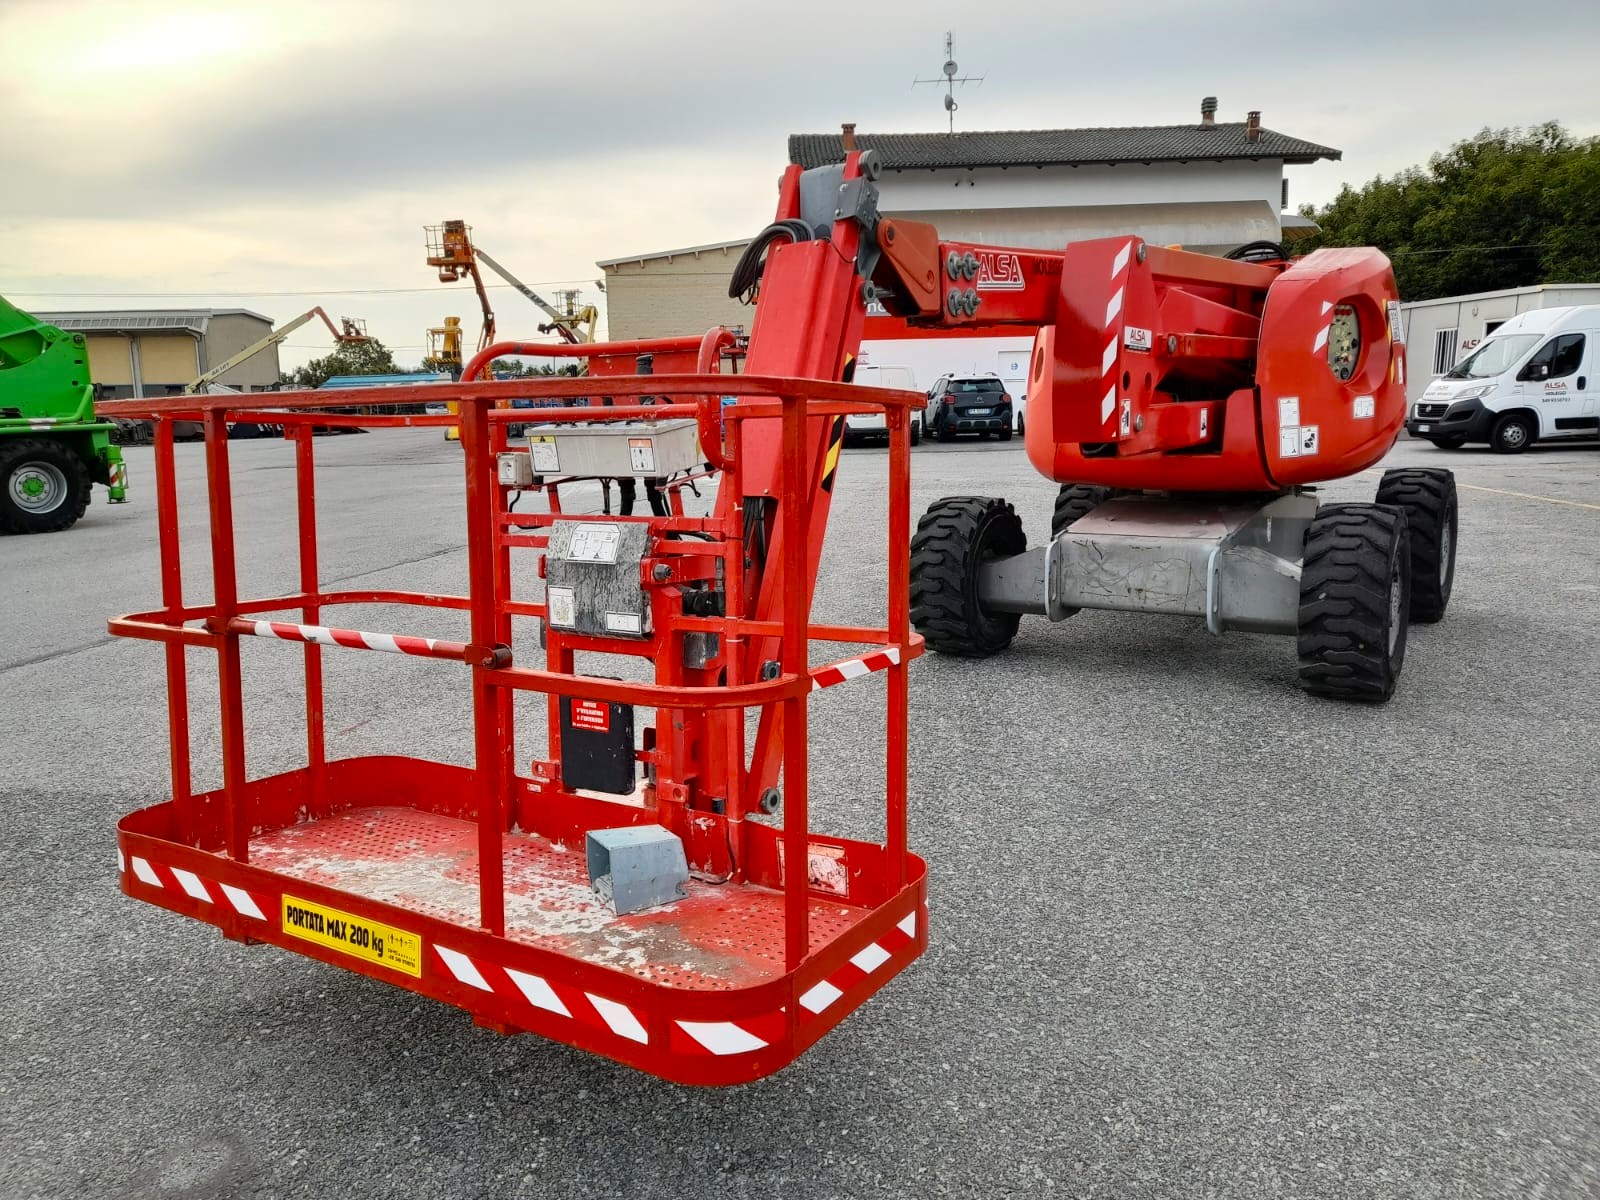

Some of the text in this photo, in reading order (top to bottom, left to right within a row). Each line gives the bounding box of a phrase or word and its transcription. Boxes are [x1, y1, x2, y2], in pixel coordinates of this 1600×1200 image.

[978, 254, 1022, 283] ALSA
[1130, 329, 1146, 341] ALSA
[287, 905, 324, 934] PORTATA
[326, 916, 347, 942] MAX
[349, 924, 369, 948] 200
[372, 930, 384, 958] kg
